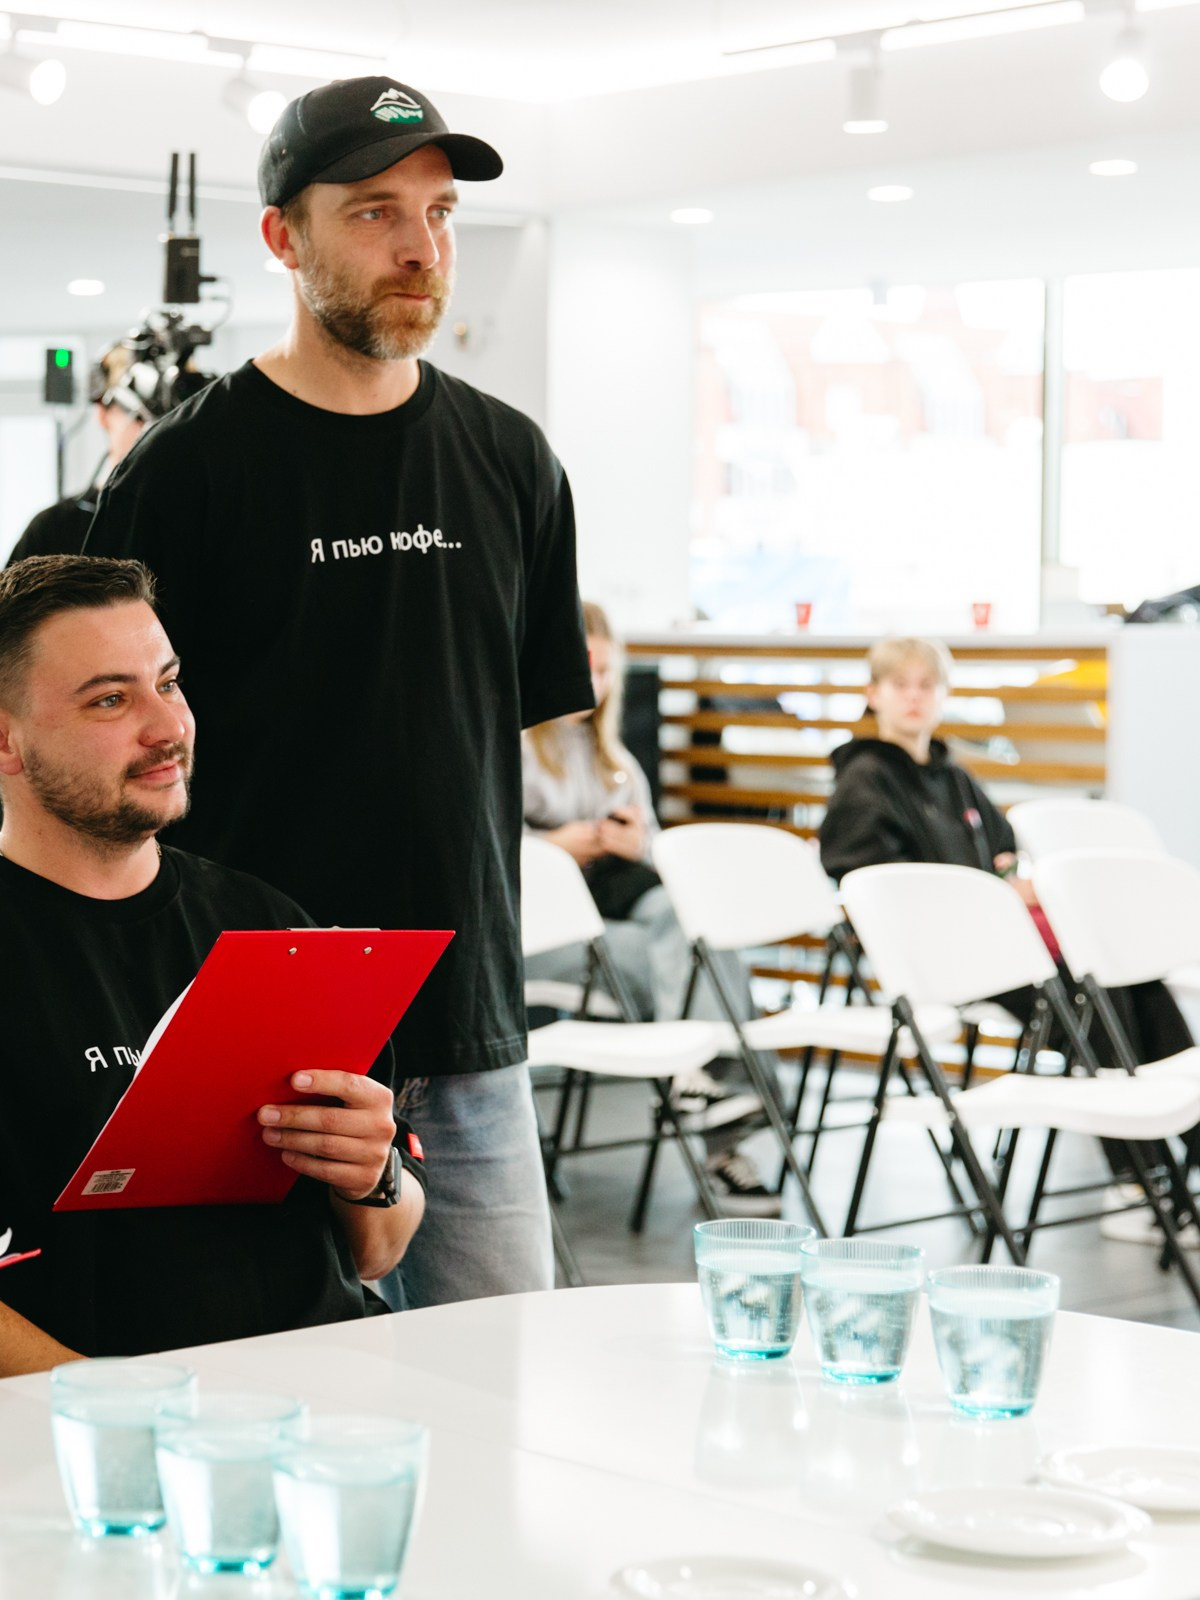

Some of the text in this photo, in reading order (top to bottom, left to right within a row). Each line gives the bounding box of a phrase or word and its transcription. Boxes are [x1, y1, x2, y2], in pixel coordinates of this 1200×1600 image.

[310, 523, 462, 564] Я пью кофе...
[84, 1046, 109, 1073] Я
